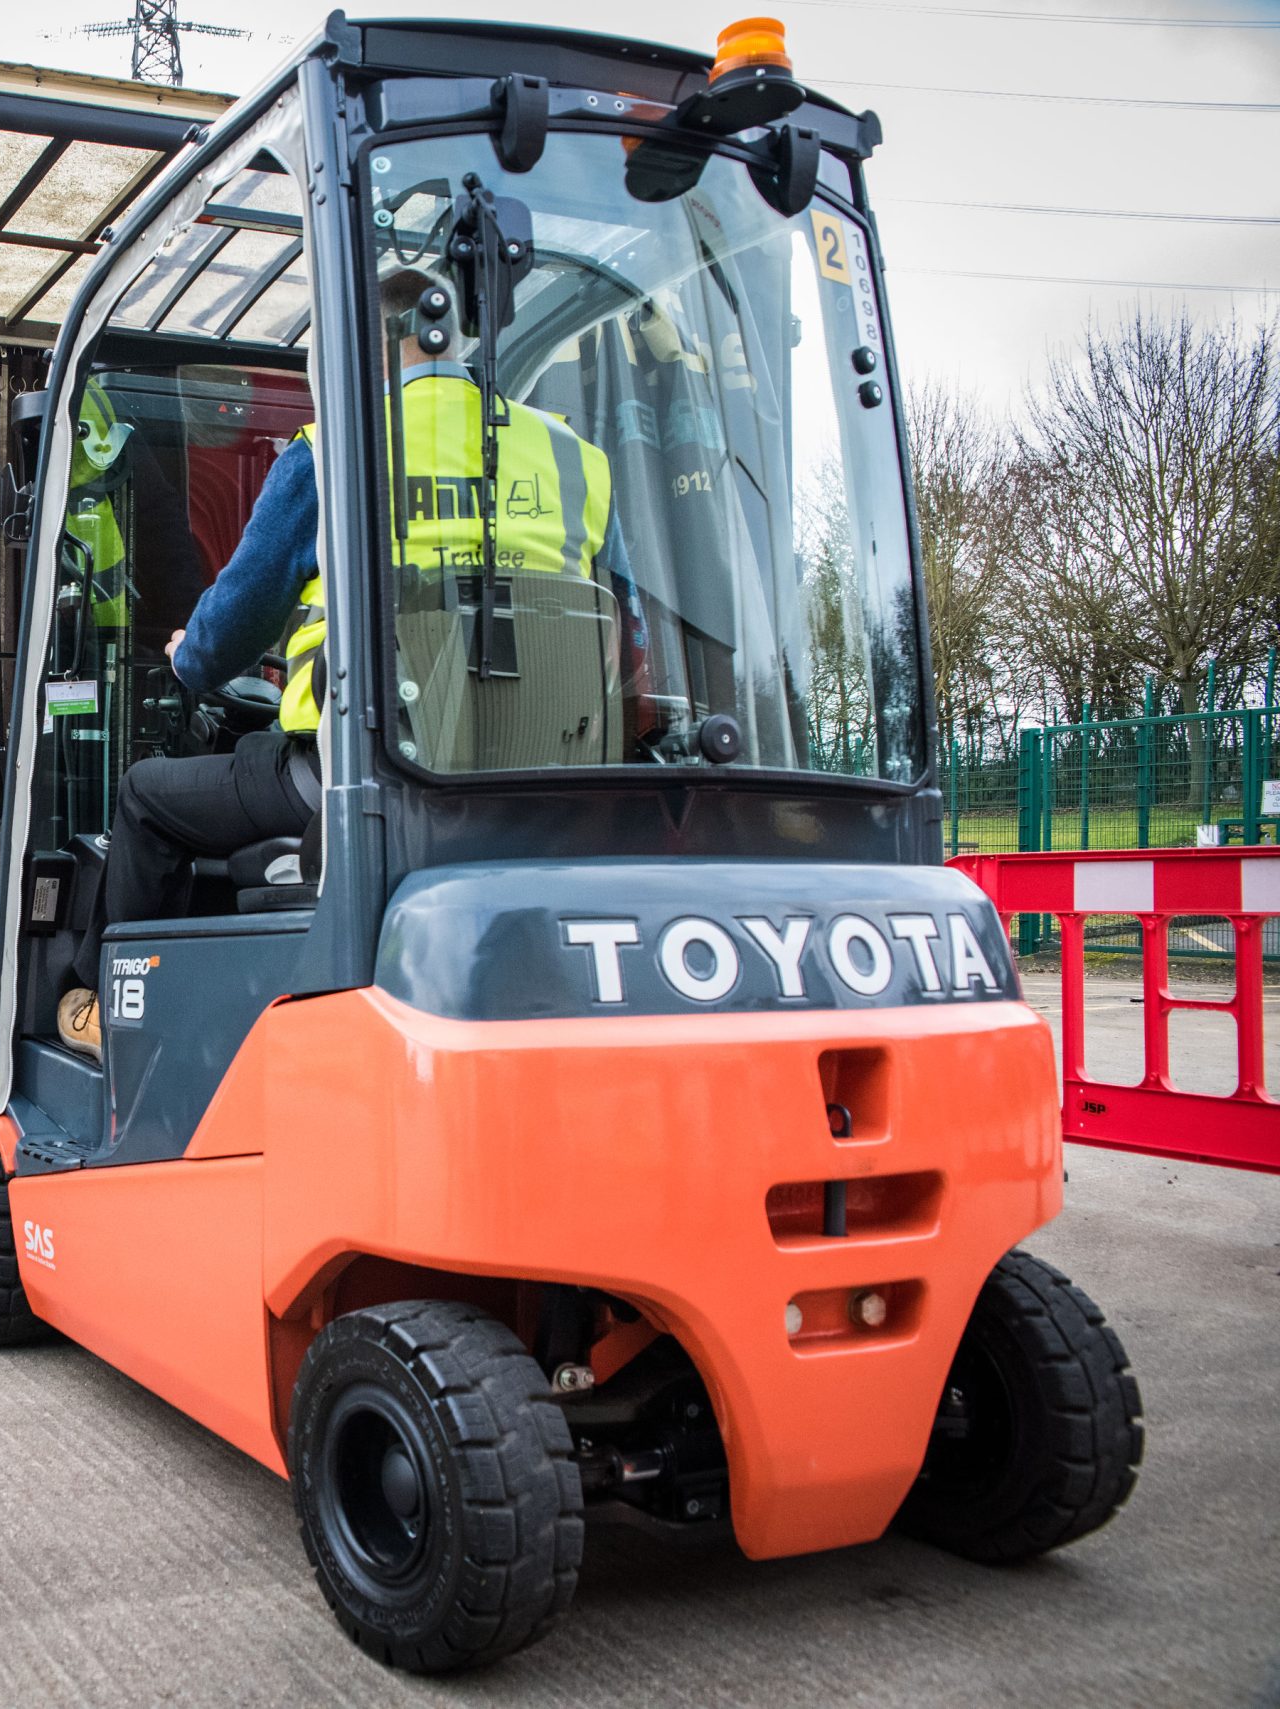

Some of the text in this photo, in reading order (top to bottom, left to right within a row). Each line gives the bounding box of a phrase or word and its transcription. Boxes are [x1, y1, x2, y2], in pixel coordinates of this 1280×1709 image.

[822, 226, 844, 270] 2
[432, 544, 525, 569] Traiee
[566, 913, 999, 1002] TOYOTA
[113, 979, 144, 1019] 18
[1082, 1101, 1106, 1115] JSP
[24, 1220, 55, 1260] SAS
